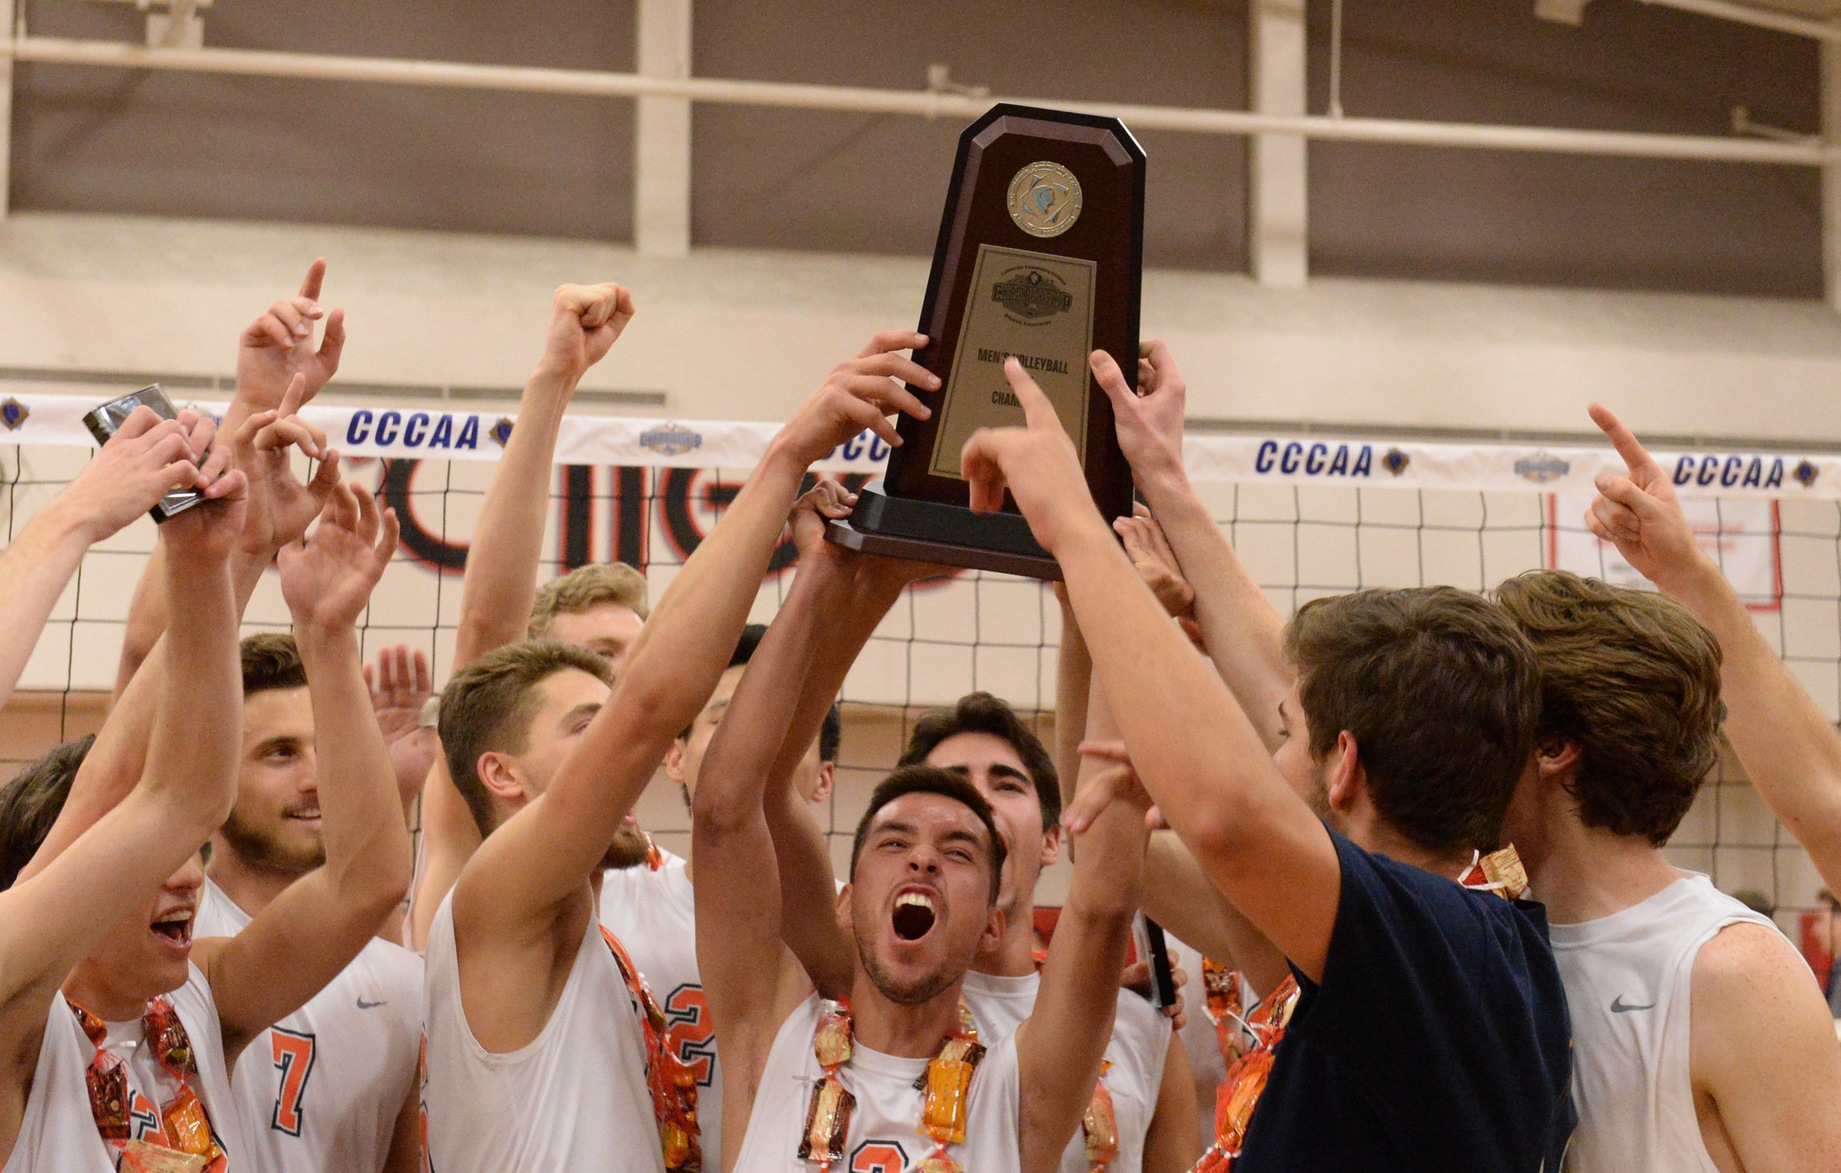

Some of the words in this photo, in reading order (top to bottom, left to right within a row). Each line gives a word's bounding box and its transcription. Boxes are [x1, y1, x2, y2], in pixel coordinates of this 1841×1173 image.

[346, 410, 479, 449] CCCAA
[1255, 441, 1372, 476] CCCAA
[1673, 456, 1784, 488] CCCAA
[271, 1025, 316, 1137] 7
